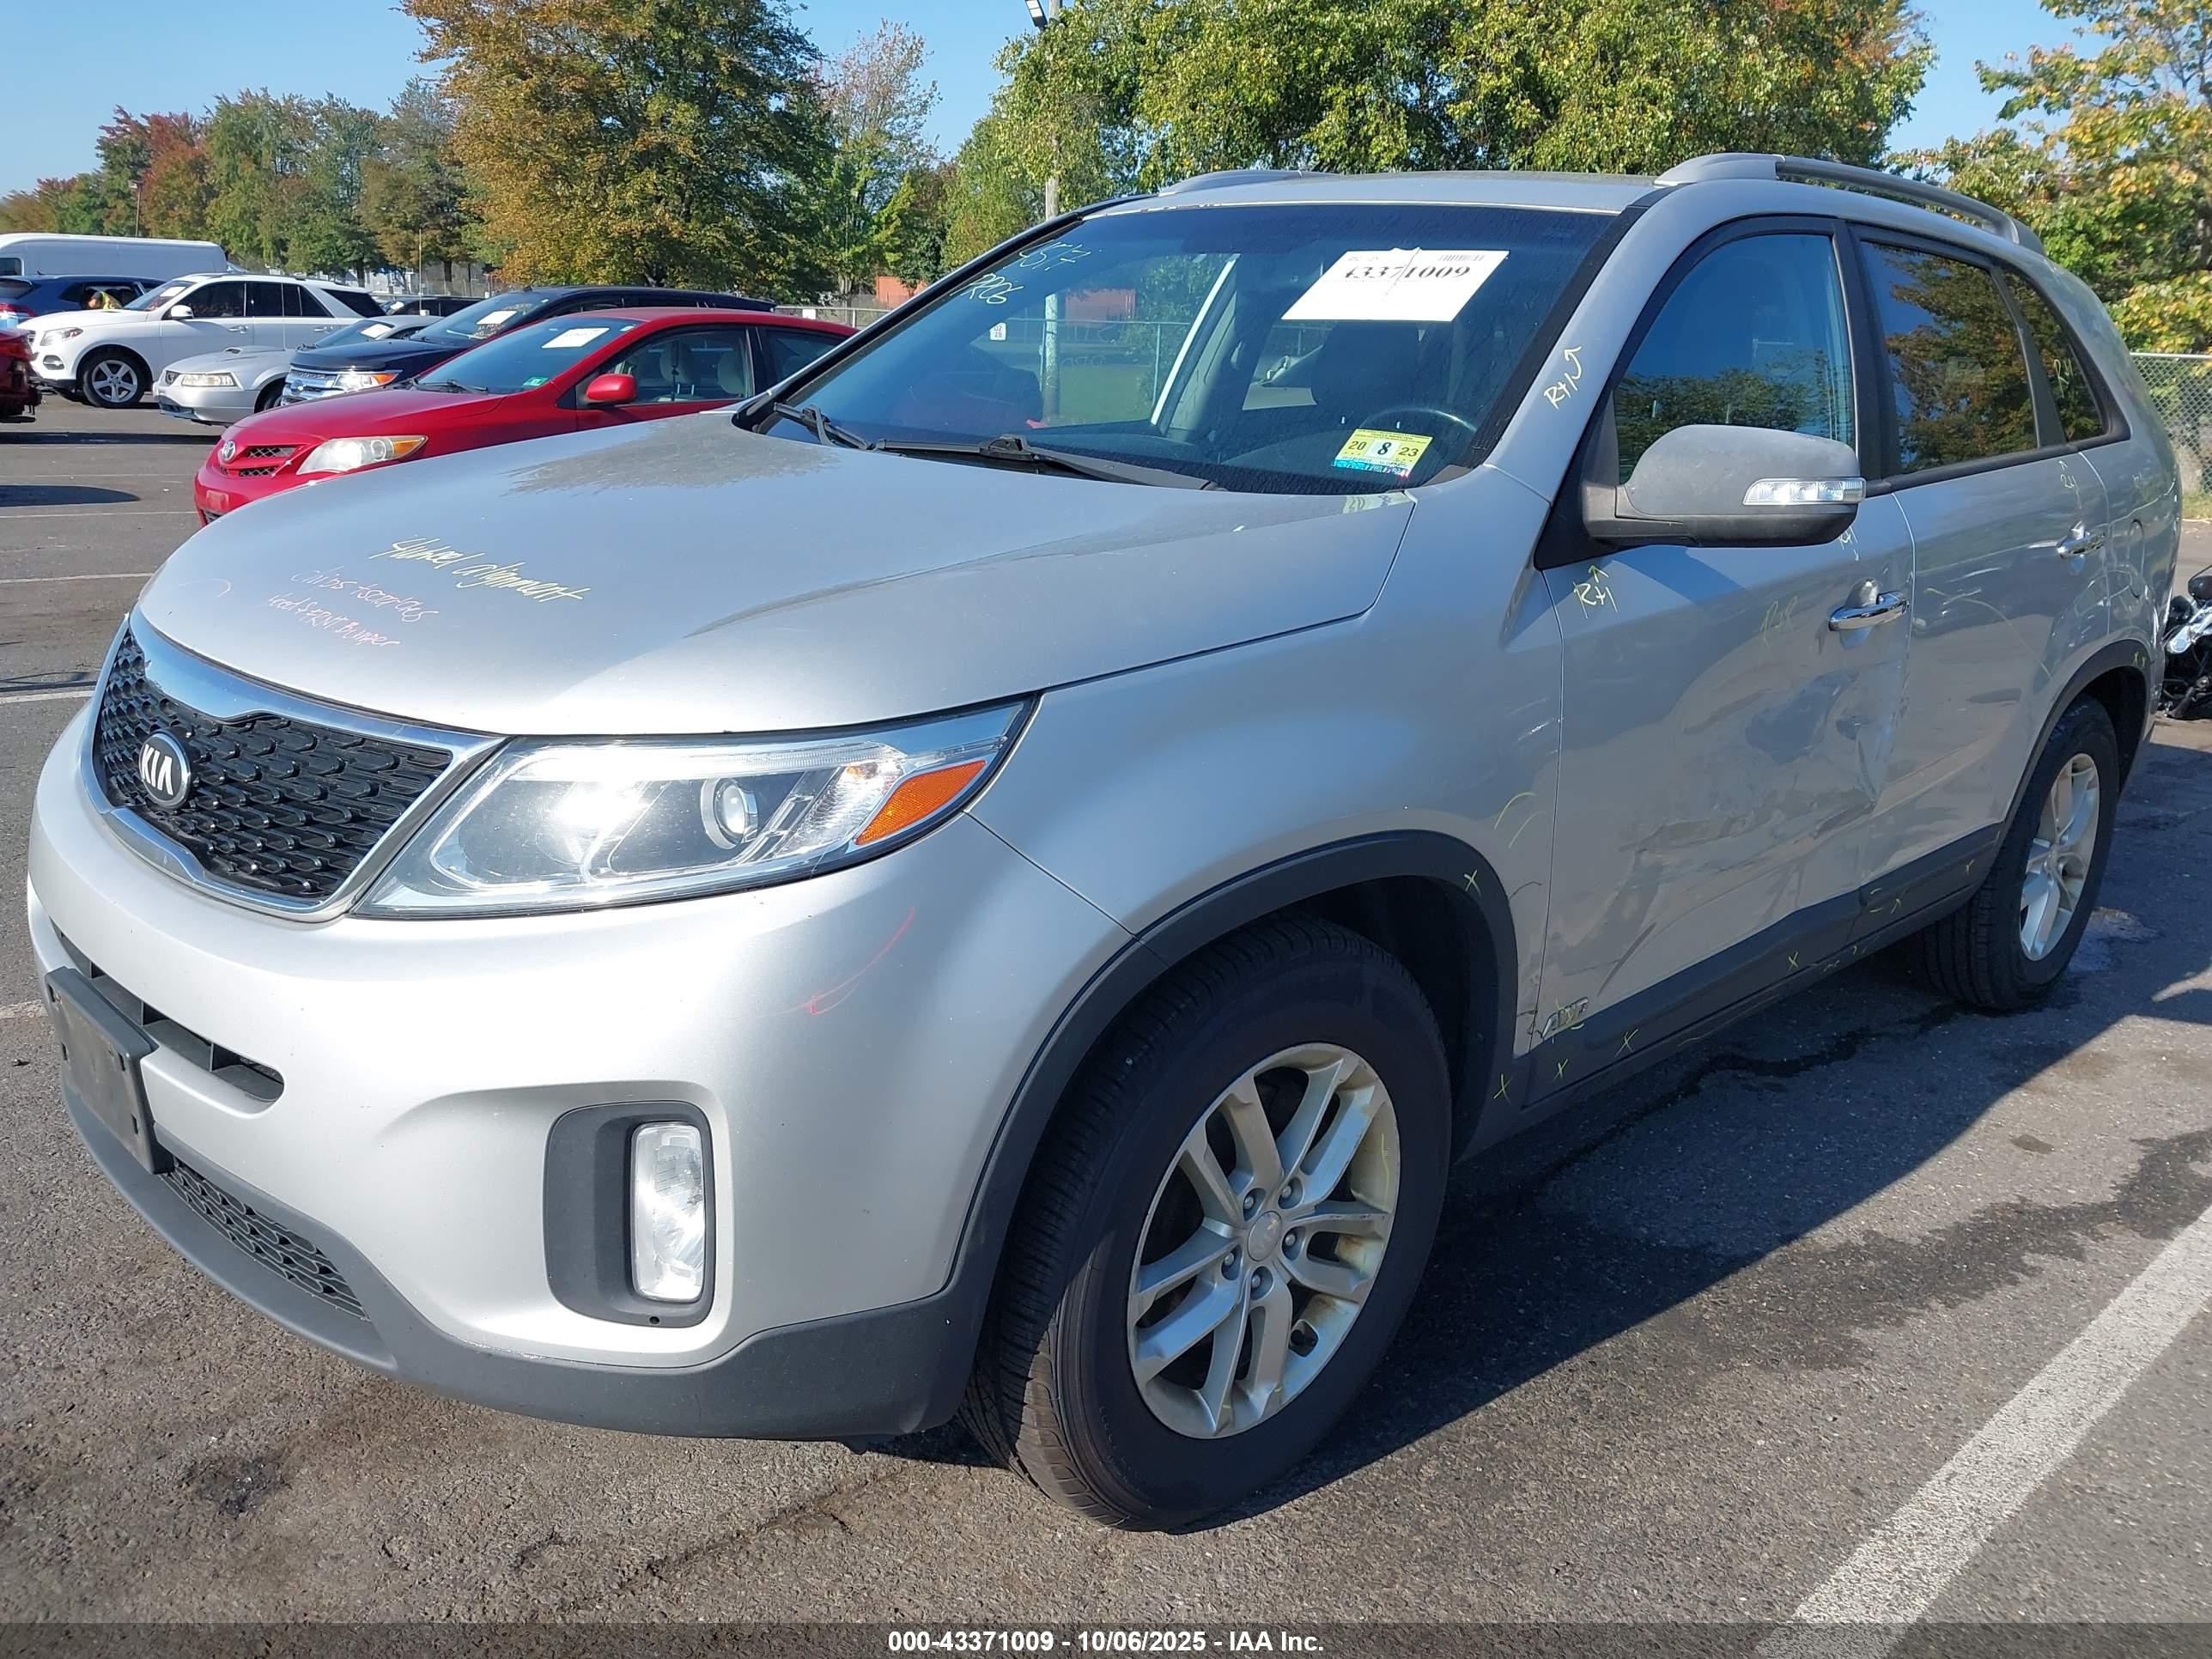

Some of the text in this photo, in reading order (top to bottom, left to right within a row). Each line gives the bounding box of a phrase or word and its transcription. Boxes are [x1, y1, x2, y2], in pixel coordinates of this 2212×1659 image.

[1348, 441, 1419, 457] 20 8 23
[141, 743, 173, 797] KIA
